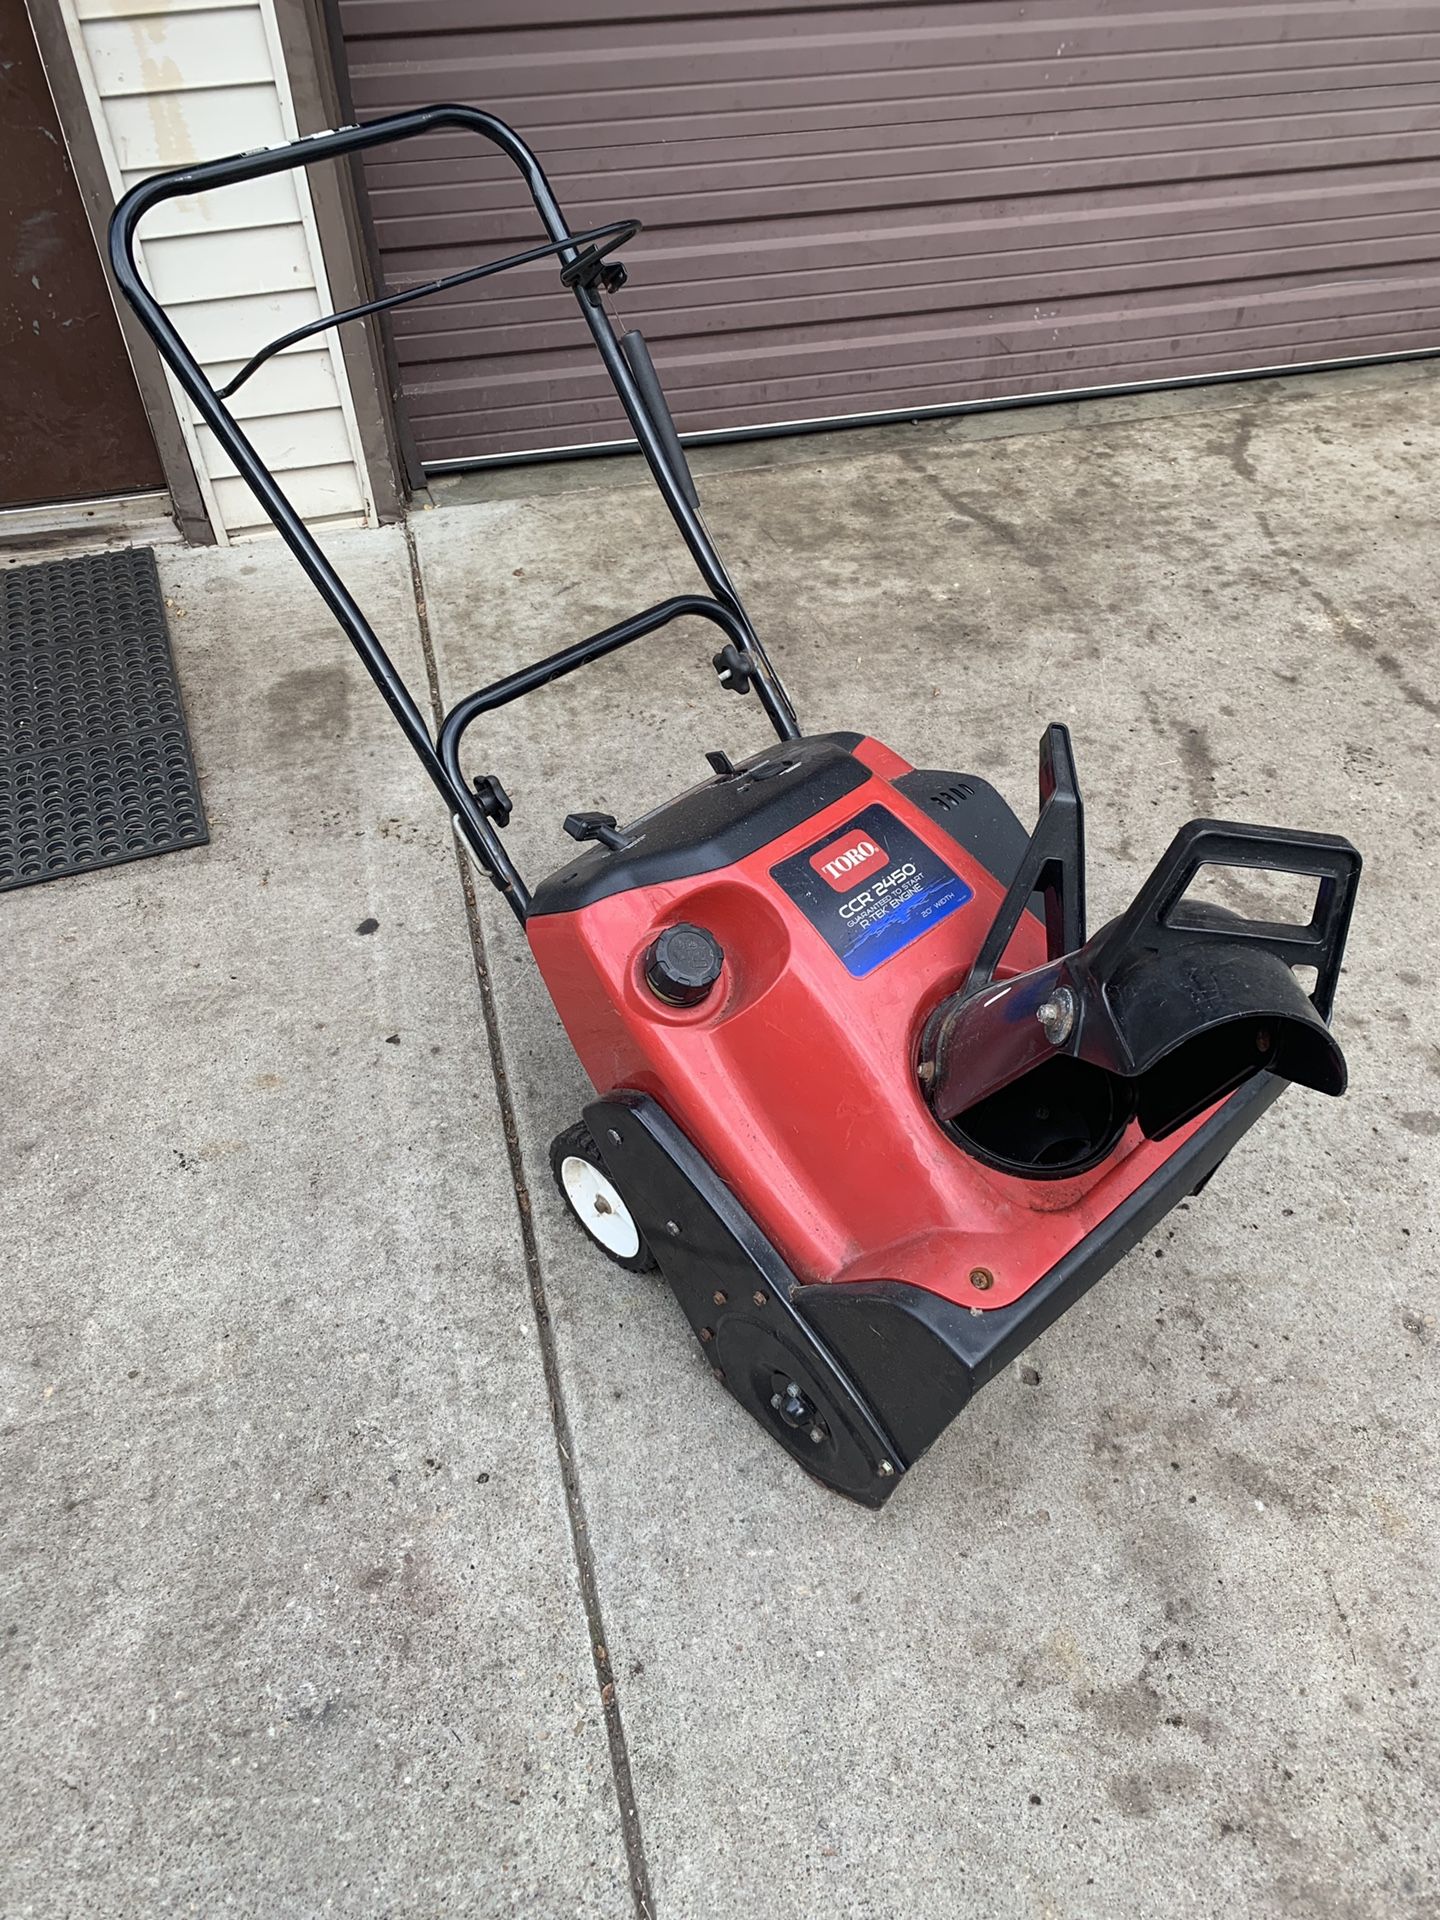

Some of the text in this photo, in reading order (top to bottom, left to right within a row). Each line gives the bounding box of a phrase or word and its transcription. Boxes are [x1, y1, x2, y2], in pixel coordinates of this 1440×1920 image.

[821, 841, 875, 880] TORO
[838, 863, 916, 919] CCR 2450
[847, 872, 925, 928] GUARANTEED TO START
[889, 884, 924, 909] ENGINE
[933, 892, 956, 909] WIDTH
